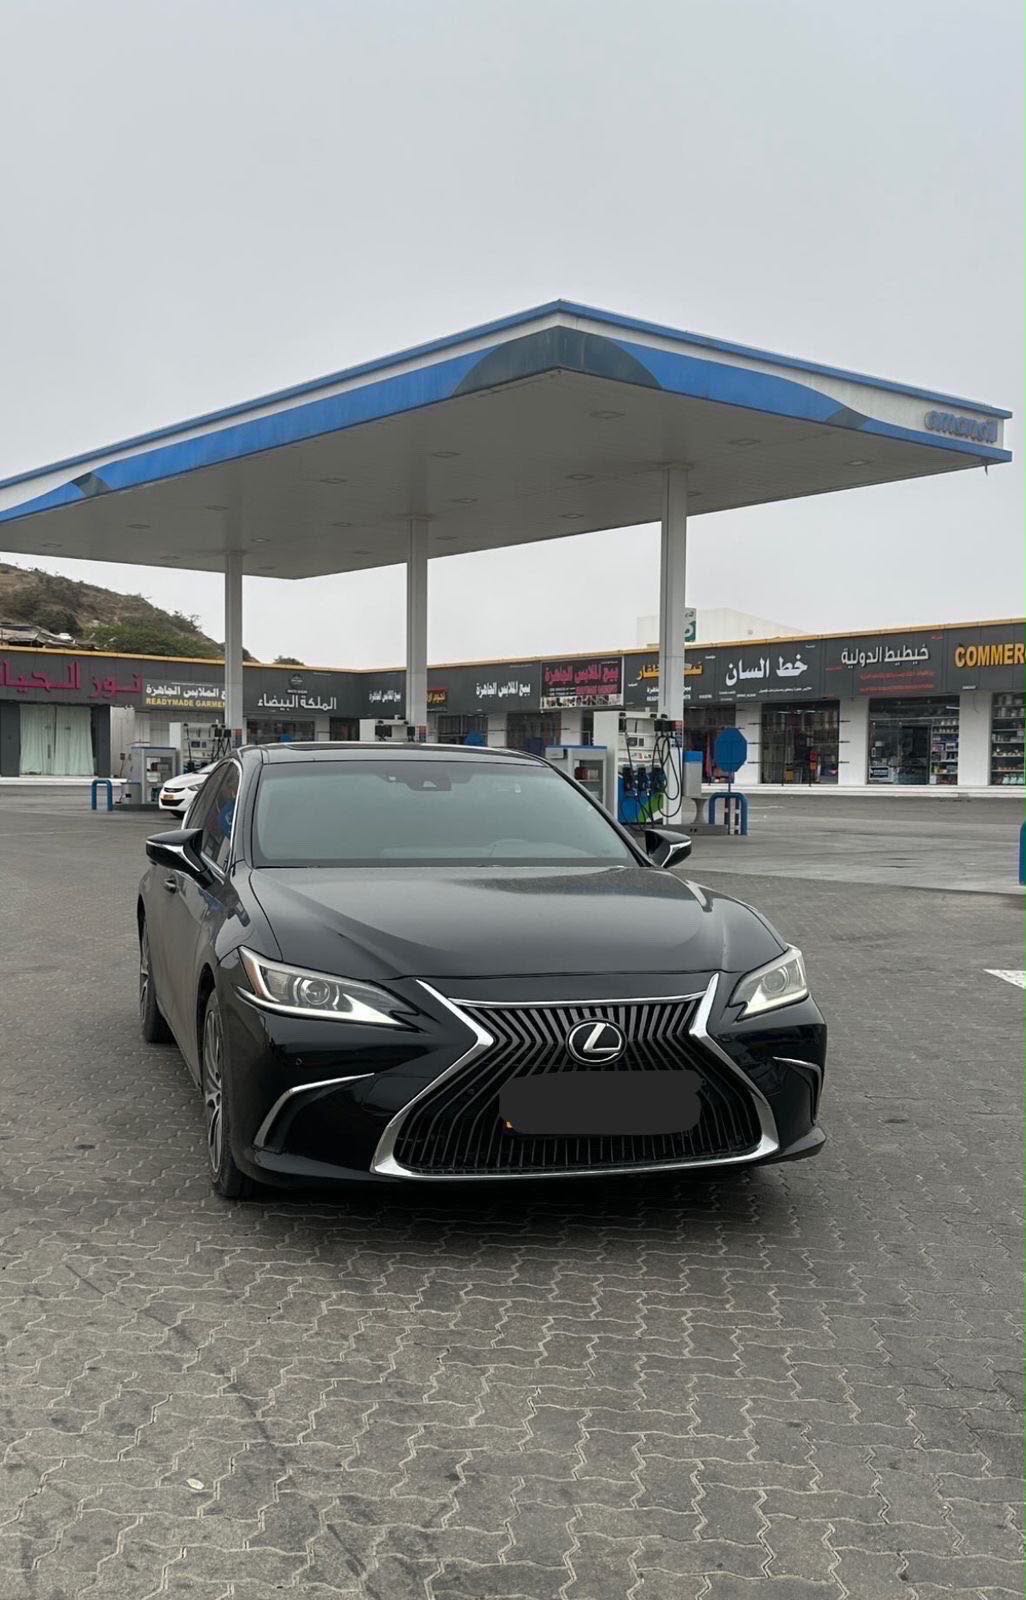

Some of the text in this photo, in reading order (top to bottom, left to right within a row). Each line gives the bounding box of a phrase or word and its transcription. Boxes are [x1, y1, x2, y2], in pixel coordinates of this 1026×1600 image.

[841, 646, 883, 669] الدولية
[955, 643, 1026, 667] COMMER
[775, 653, 808, 677] خط
[0, 656, 81, 694] الحيا
[146, 684, 181, 697] الجاهزة
[183, 687, 219, 699] الملابس
[476, 682, 497, 699] الجاهزة
[498, 681, 518, 698] الملابس
[519, 683, 531, 697] بيع
[146, 697, 195, 707] READYMADE
[257, 693, 337, 712] الملكة البيضاء
